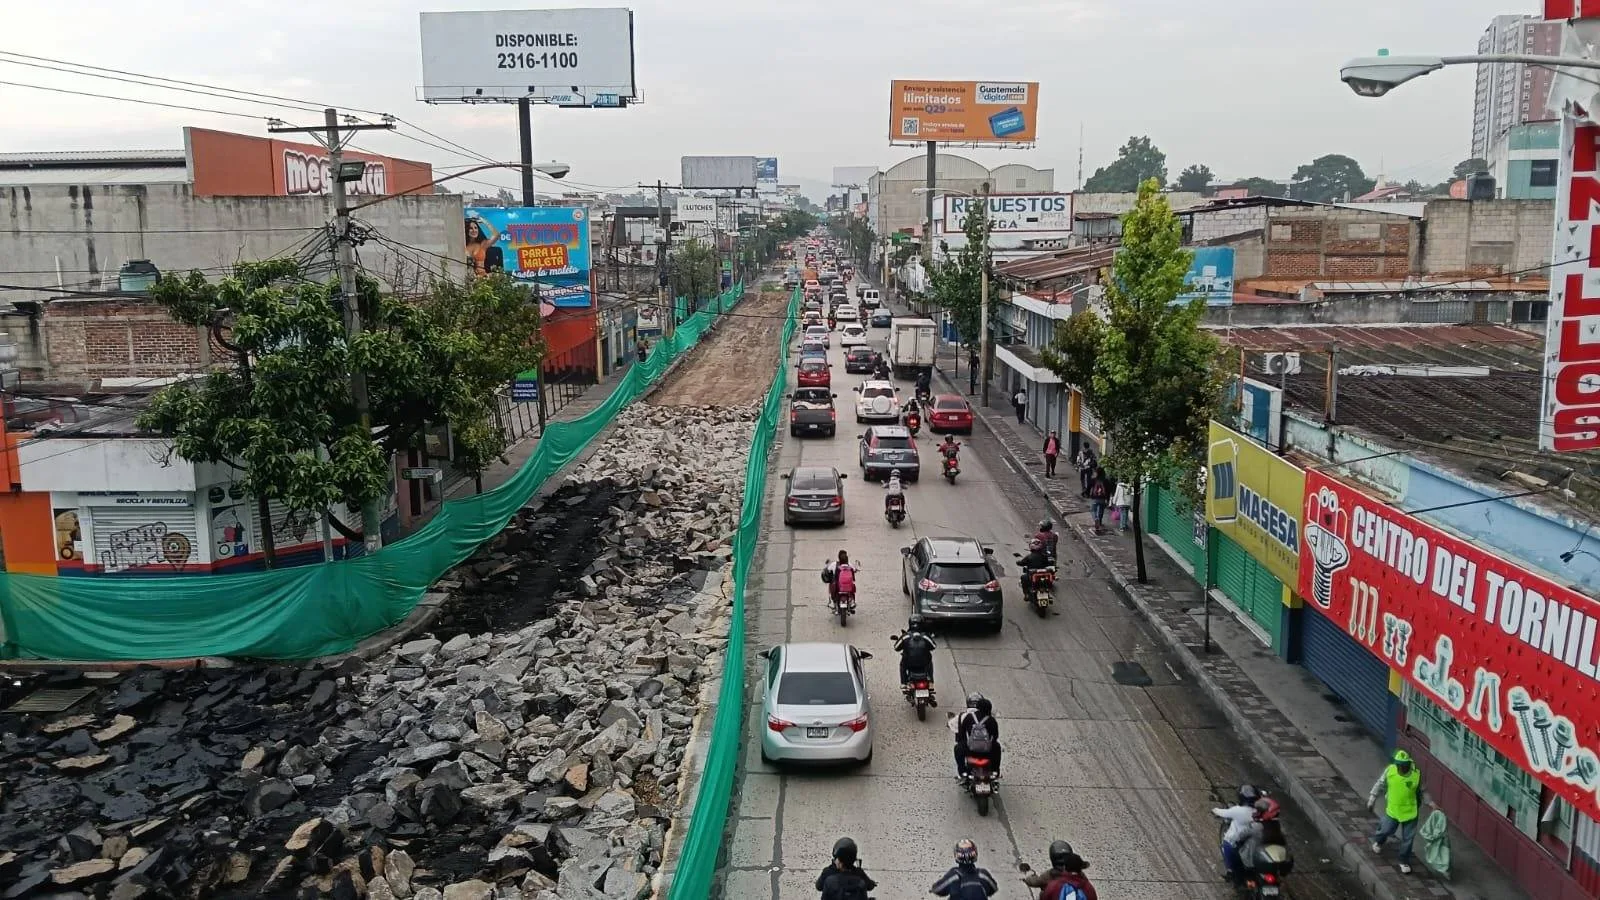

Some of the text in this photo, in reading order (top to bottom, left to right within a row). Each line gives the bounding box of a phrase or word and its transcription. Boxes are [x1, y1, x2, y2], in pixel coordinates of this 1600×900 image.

[495, 33, 578, 47] DISPONIBLE:
[497, 52, 578, 68] 2316-1100
[979, 85, 1025, 93] Guatemala
[925, 104, 946, 114] Q29
[952, 197, 1065, 213] REUESTOS
[500, 226, 575, 244] DE TODO
[521, 246, 564, 258] PARA LA
[523, 256, 564, 269] MALETA
[537, 267, 549, 277] la
[549, 264, 580, 276] maleta
[1239, 483, 1299, 555] MASESA
[1351, 505, 1600, 681] CENTRO DEL TORNIL
